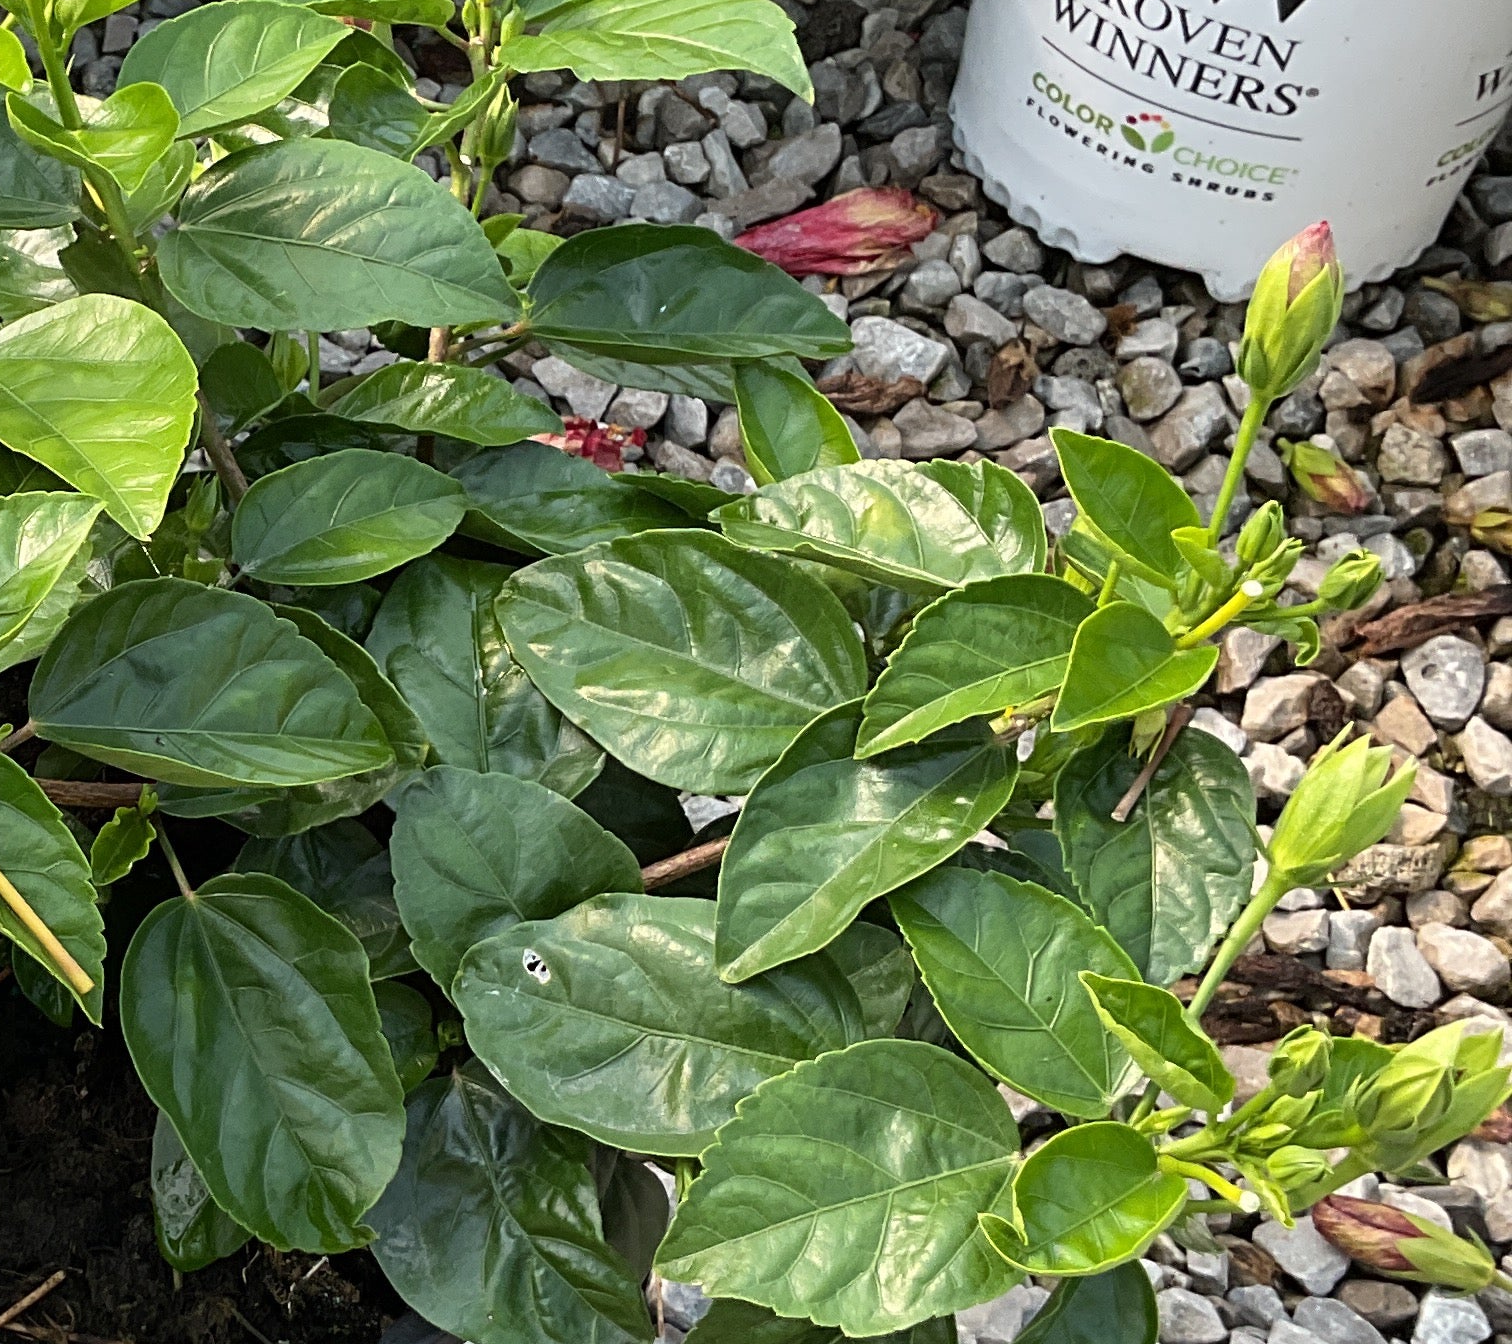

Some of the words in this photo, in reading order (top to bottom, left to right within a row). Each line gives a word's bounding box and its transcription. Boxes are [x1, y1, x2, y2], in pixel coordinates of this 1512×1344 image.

[1025, 97, 1156, 174] FLOWERING
[1171, 172, 1276, 202] SHRUBS
[1032, 71, 1116, 136] COLOR
[1172, 147, 1291, 186] CHOICE
